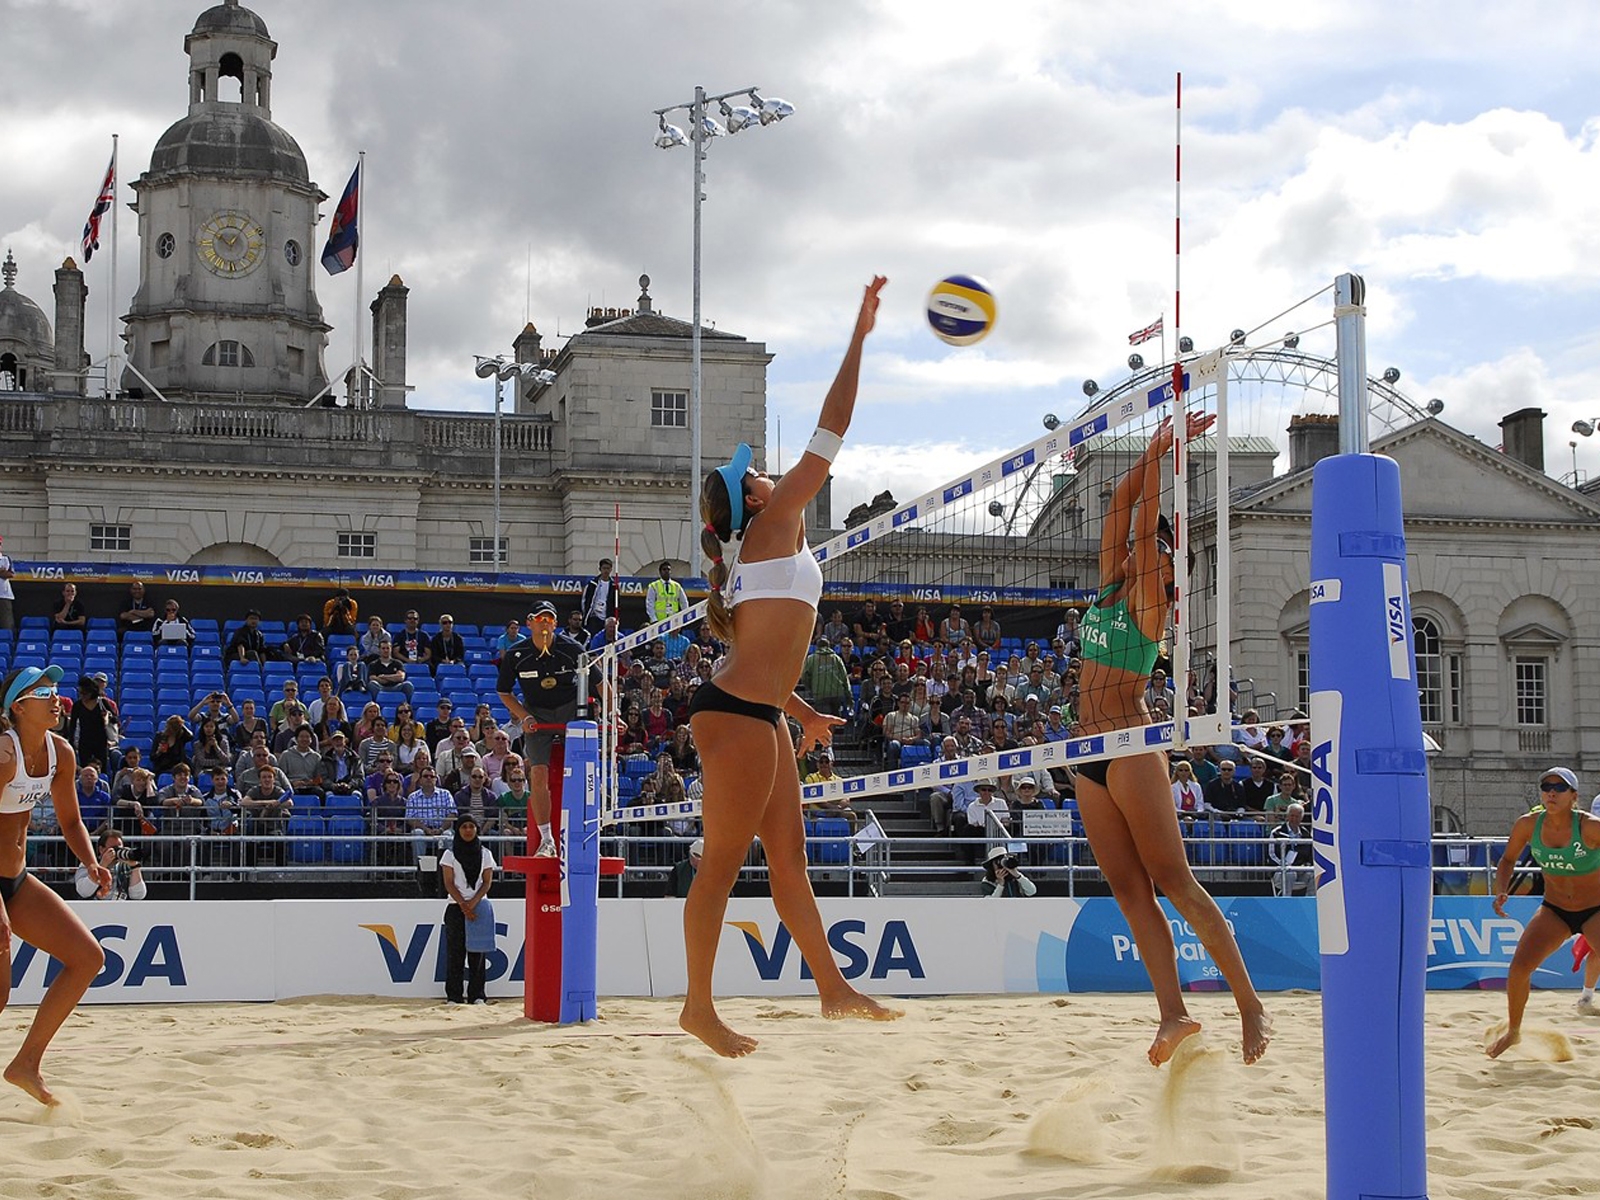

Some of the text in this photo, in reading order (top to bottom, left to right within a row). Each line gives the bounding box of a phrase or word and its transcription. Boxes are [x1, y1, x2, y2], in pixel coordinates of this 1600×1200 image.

[1081, 423, 1095, 438] VISA
[1013, 455, 1024, 469] VISA
[30, 567, 65, 580] VISA
[165, 569, 200, 582] VISA
[230, 571, 265, 584] VISA
[362, 574, 395, 587] VISA
[424, 576, 457, 589] VISA
[551, 580, 583, 593] VISA
[912, 589, 941, 601] VISA
[968, 590, 998, 602] VISA
[1388, 596, 1405, 646] VISA
[1081, 625, 1108, 649] VISA
[1080, 741, 1092, 753] VISA
[1009, 753, 1021, 766] VISA
[1025, 812, 1043, 820] Seating
[1311, 740, 1337, 890] VISA
[1573, 841, 1583, 852] 2
[1540, 861, 1576, 871] VISA
[1427, 918, 1525, 956] FIVB
